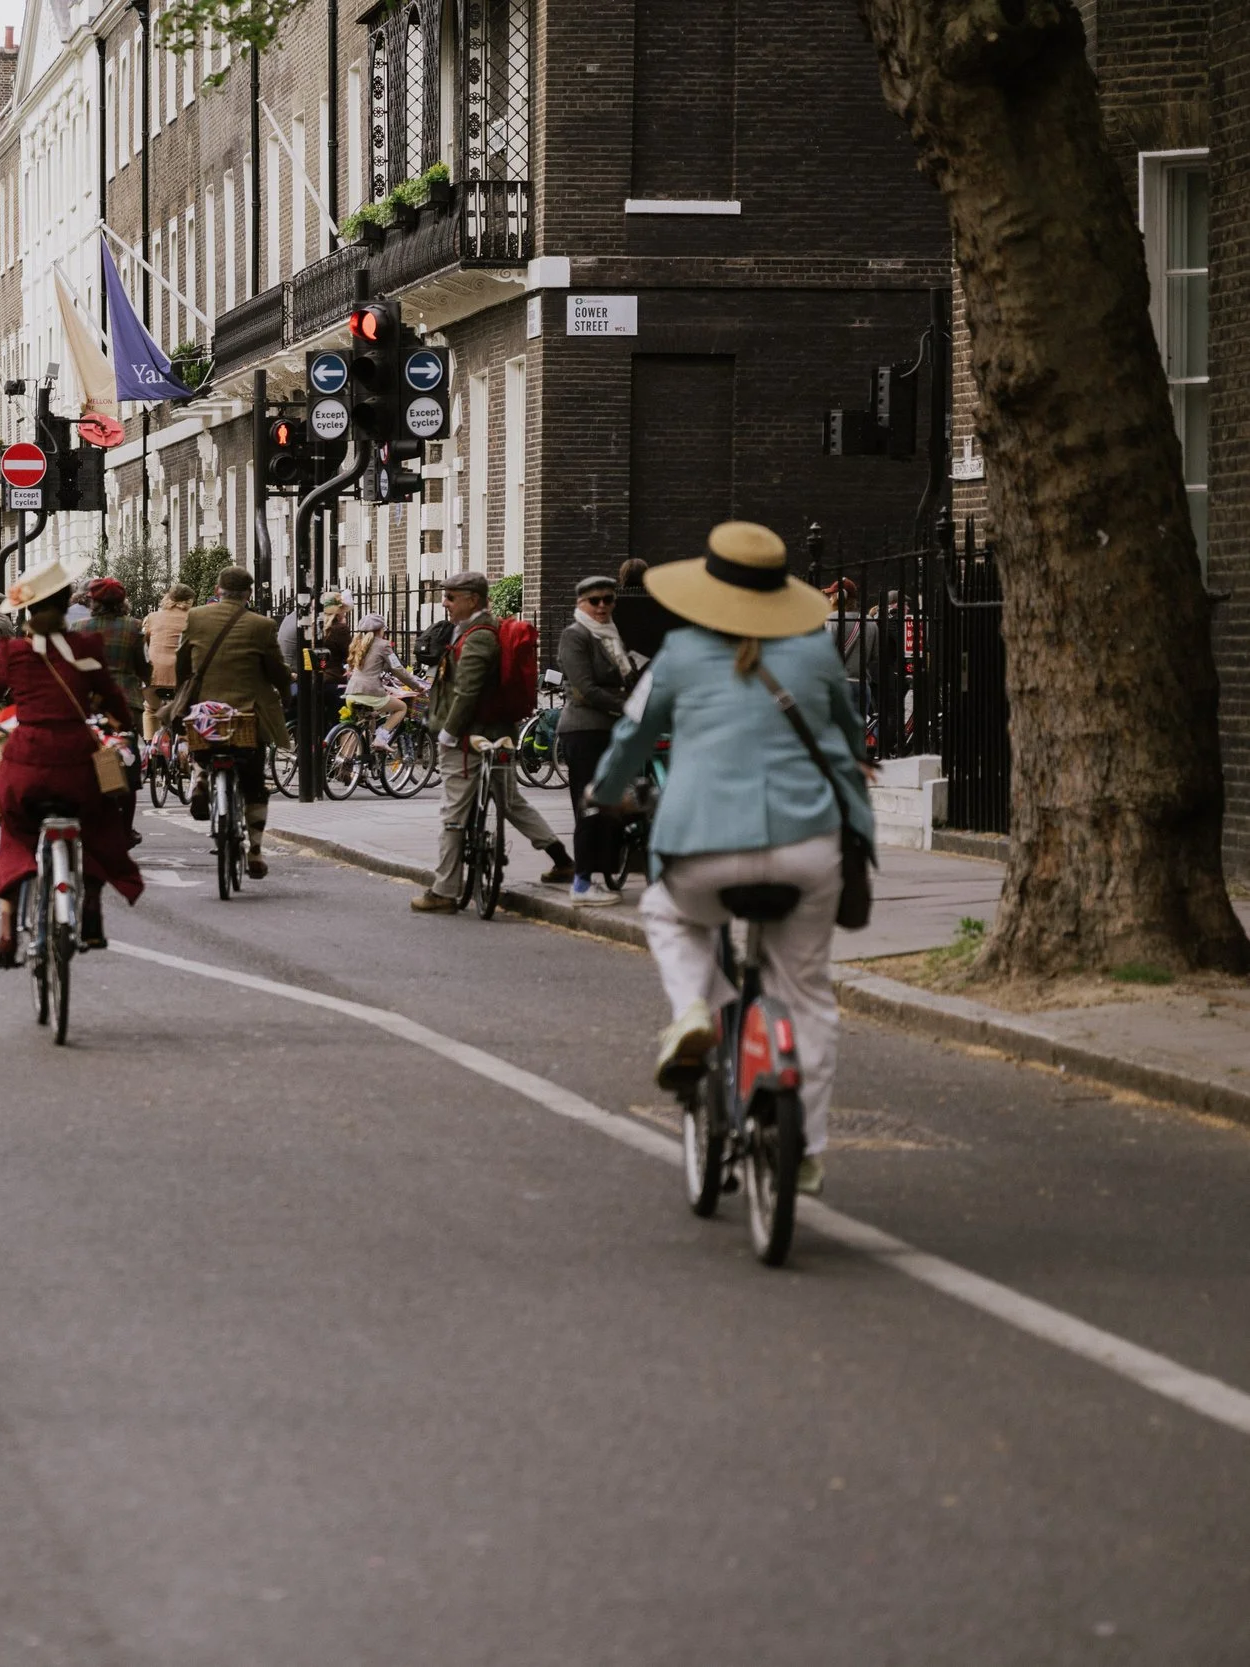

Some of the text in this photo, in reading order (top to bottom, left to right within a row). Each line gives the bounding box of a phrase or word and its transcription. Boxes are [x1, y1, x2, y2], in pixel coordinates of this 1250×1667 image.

[575, 307, 608, 318] GOWER
[574, 320, 609, 332] STREET
[131, 363, 170, 384] Yal
[315, 410, 345, 420] Except
[409, 408, 440, 418] Except
[316, 420, 344, 430] cycles
[411, 418, 440, 428] cycles
[14, 491, 39, 499] Except
